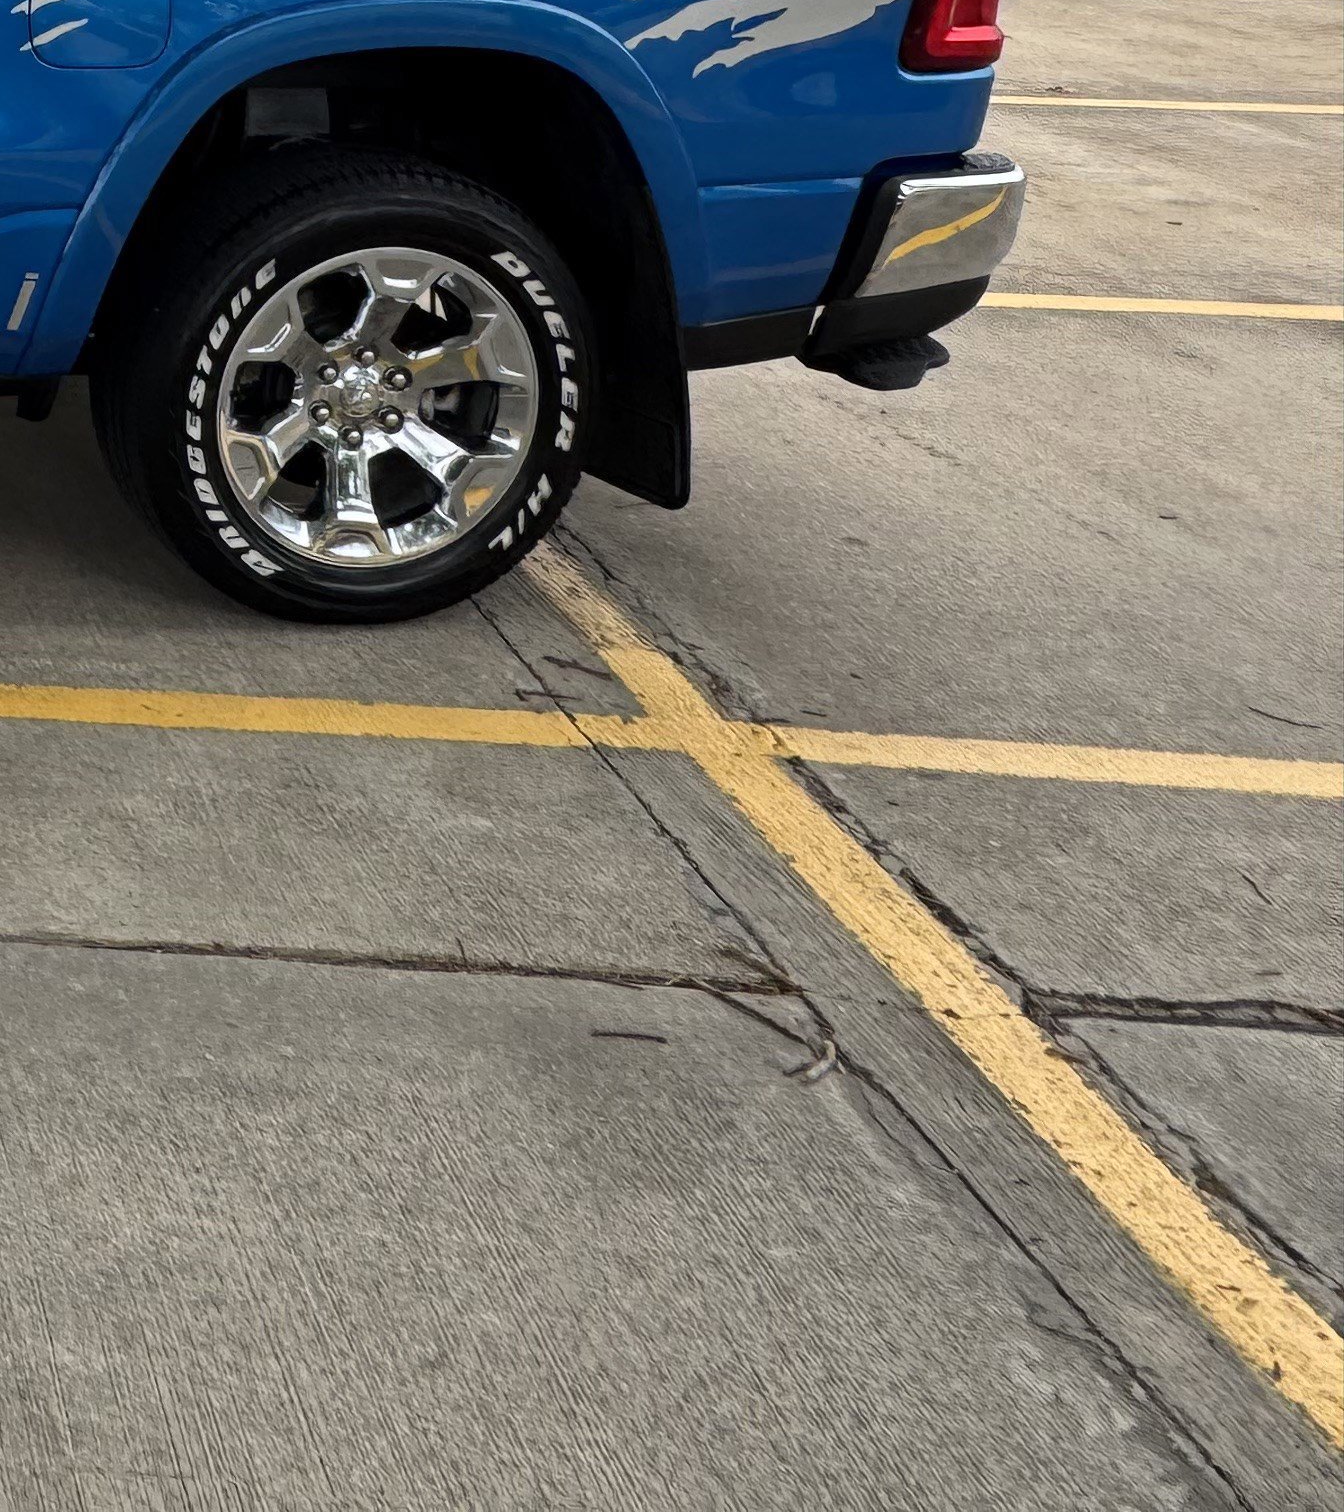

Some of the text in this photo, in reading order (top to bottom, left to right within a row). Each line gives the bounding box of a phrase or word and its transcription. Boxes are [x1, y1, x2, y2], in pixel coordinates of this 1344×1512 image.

[186, 251, 578, 575] BRIDGESTONE DUELER H/L
